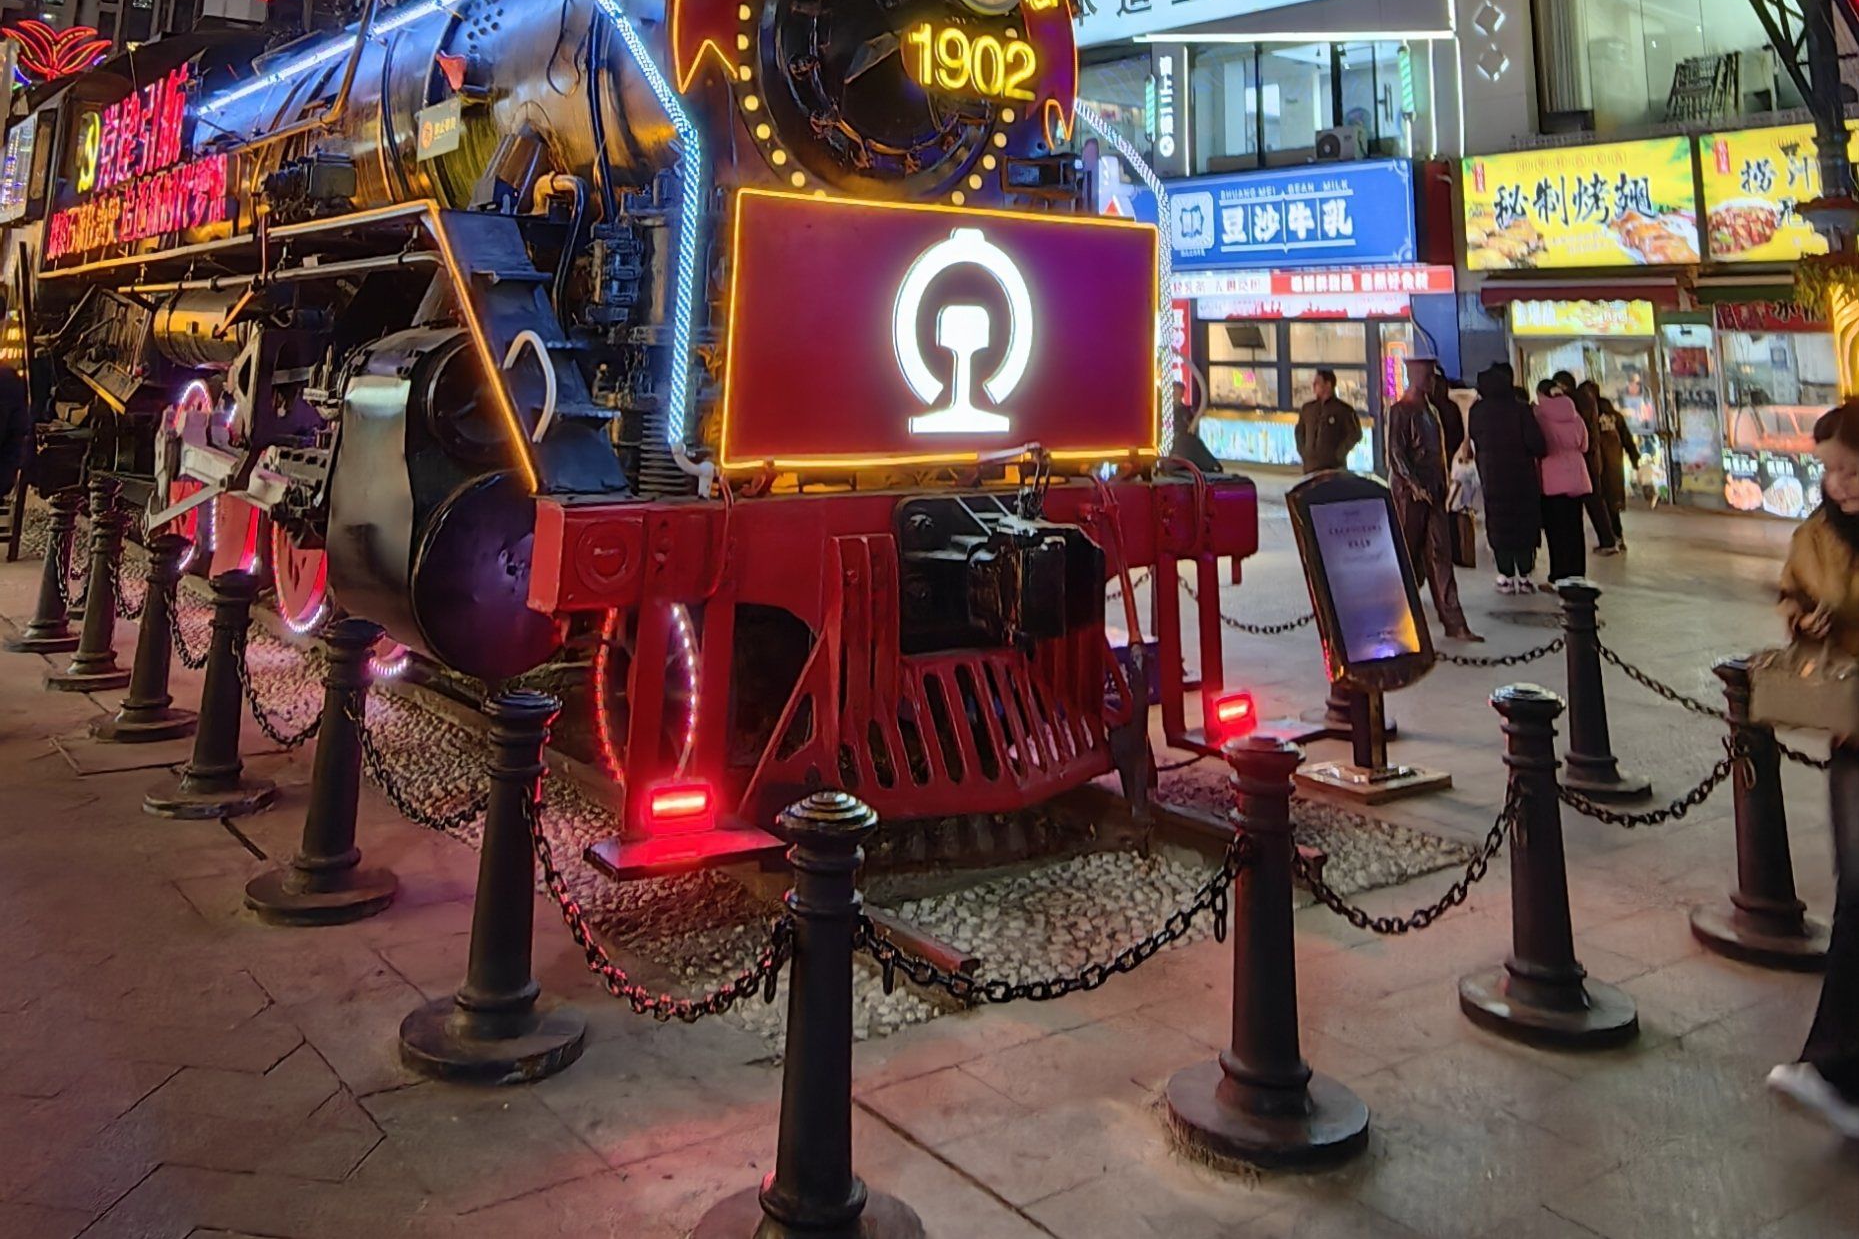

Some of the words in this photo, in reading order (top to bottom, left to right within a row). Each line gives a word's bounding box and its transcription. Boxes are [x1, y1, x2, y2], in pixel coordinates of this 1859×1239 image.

[909, 23, 1037, 102] 1902
[1322, 179, 1348, 191] MILK
[1493, 172, 1658, 230] 秘制烤翅
[1221, 199, 1353, 244] 豆沙牛乳
